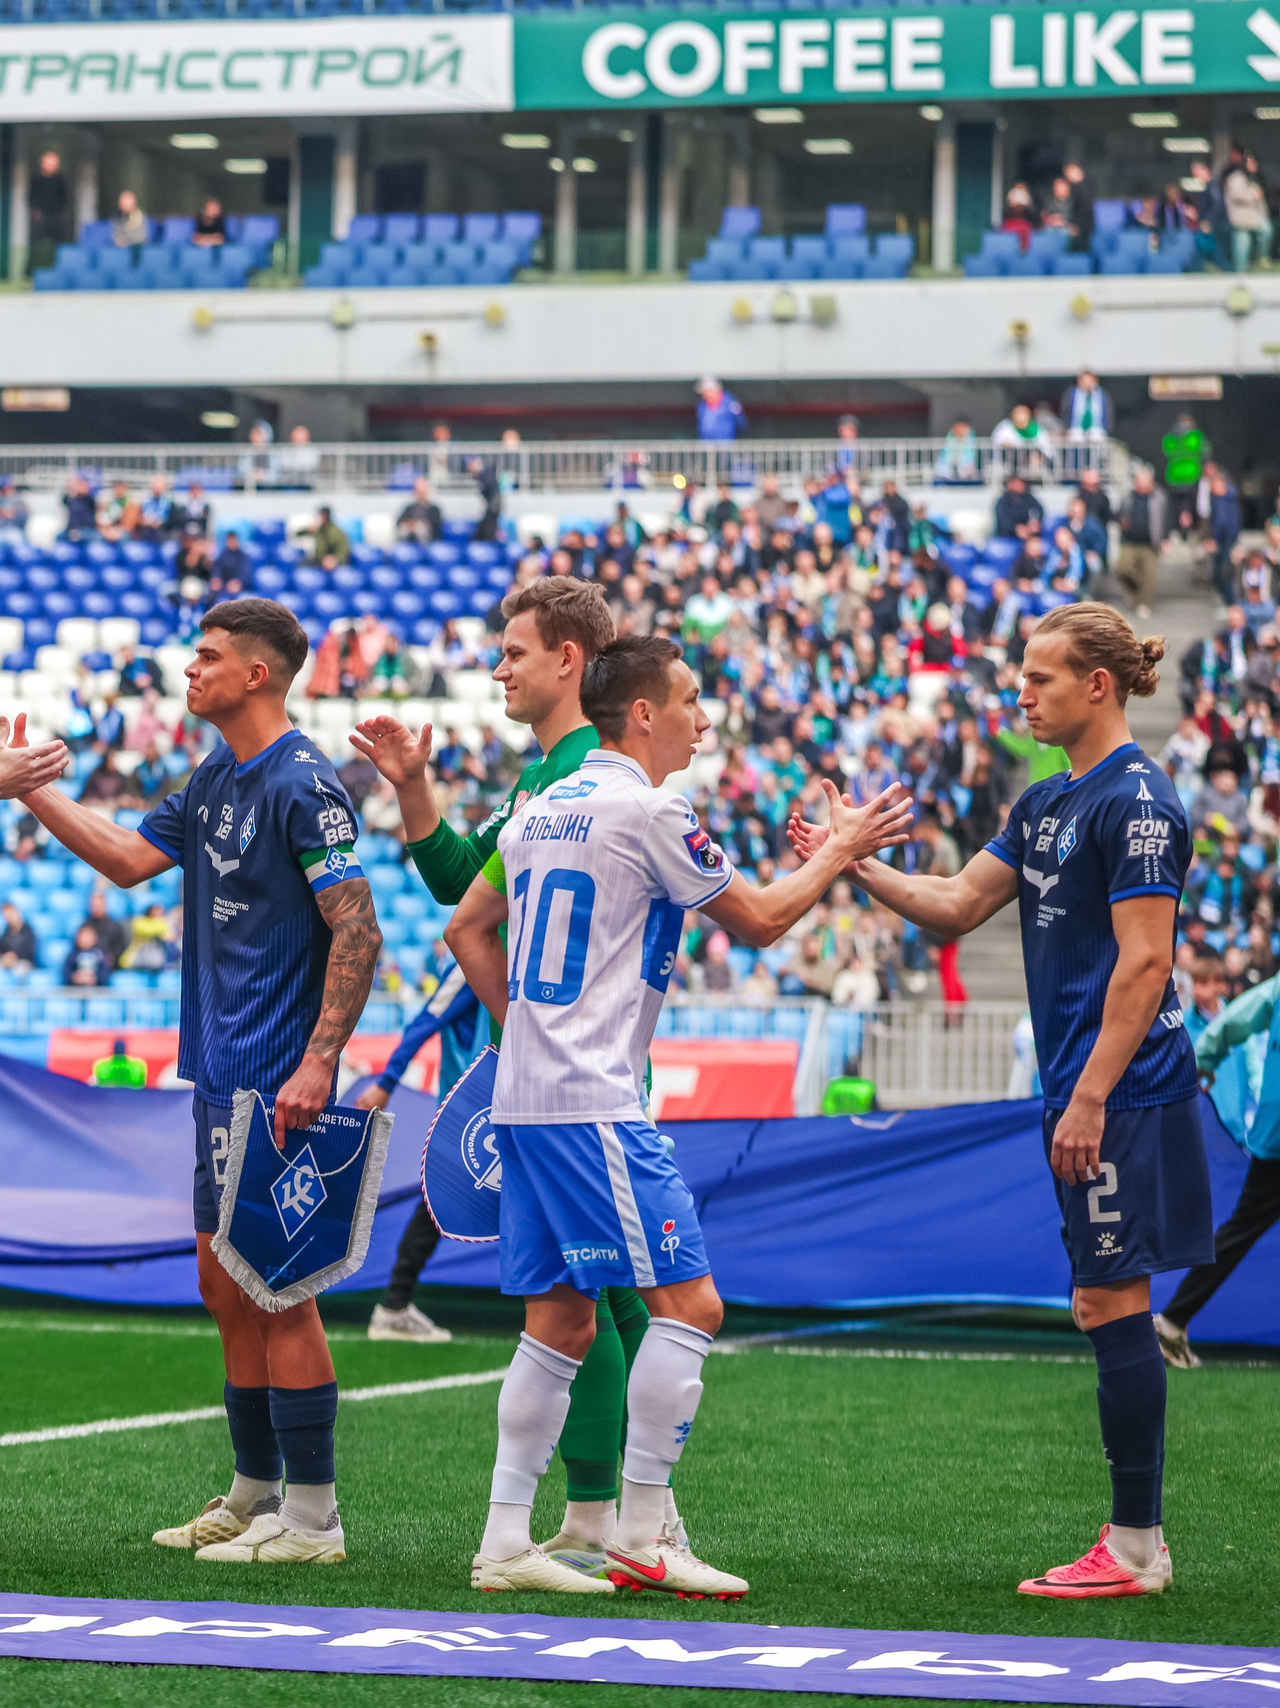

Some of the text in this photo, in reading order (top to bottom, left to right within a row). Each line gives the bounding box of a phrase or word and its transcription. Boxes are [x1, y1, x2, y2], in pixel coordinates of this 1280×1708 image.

[582, 9, 1196, 98] COFFEE LIKE
[318, 806, 349, 830] FON
[521, 814, 594, 843] АЛЬШИН
[1126, 819, 1170, 838] FON
[324, 823, 356, 847] BET
[1128, 837, 1170, 857] BET
[508, 868, 596, 1006] 10
[318, 1113, 361, 1128] ОВЕТОВ»
[467, 1115, 488, 1170] ФУТБОЛЬНЫЙ
[1087, 1162, 1121, 1223] 2
[562, 1247, 619, 1264] ЕТСИТИ
[1095, 1246, 1124, 1256] KELME
